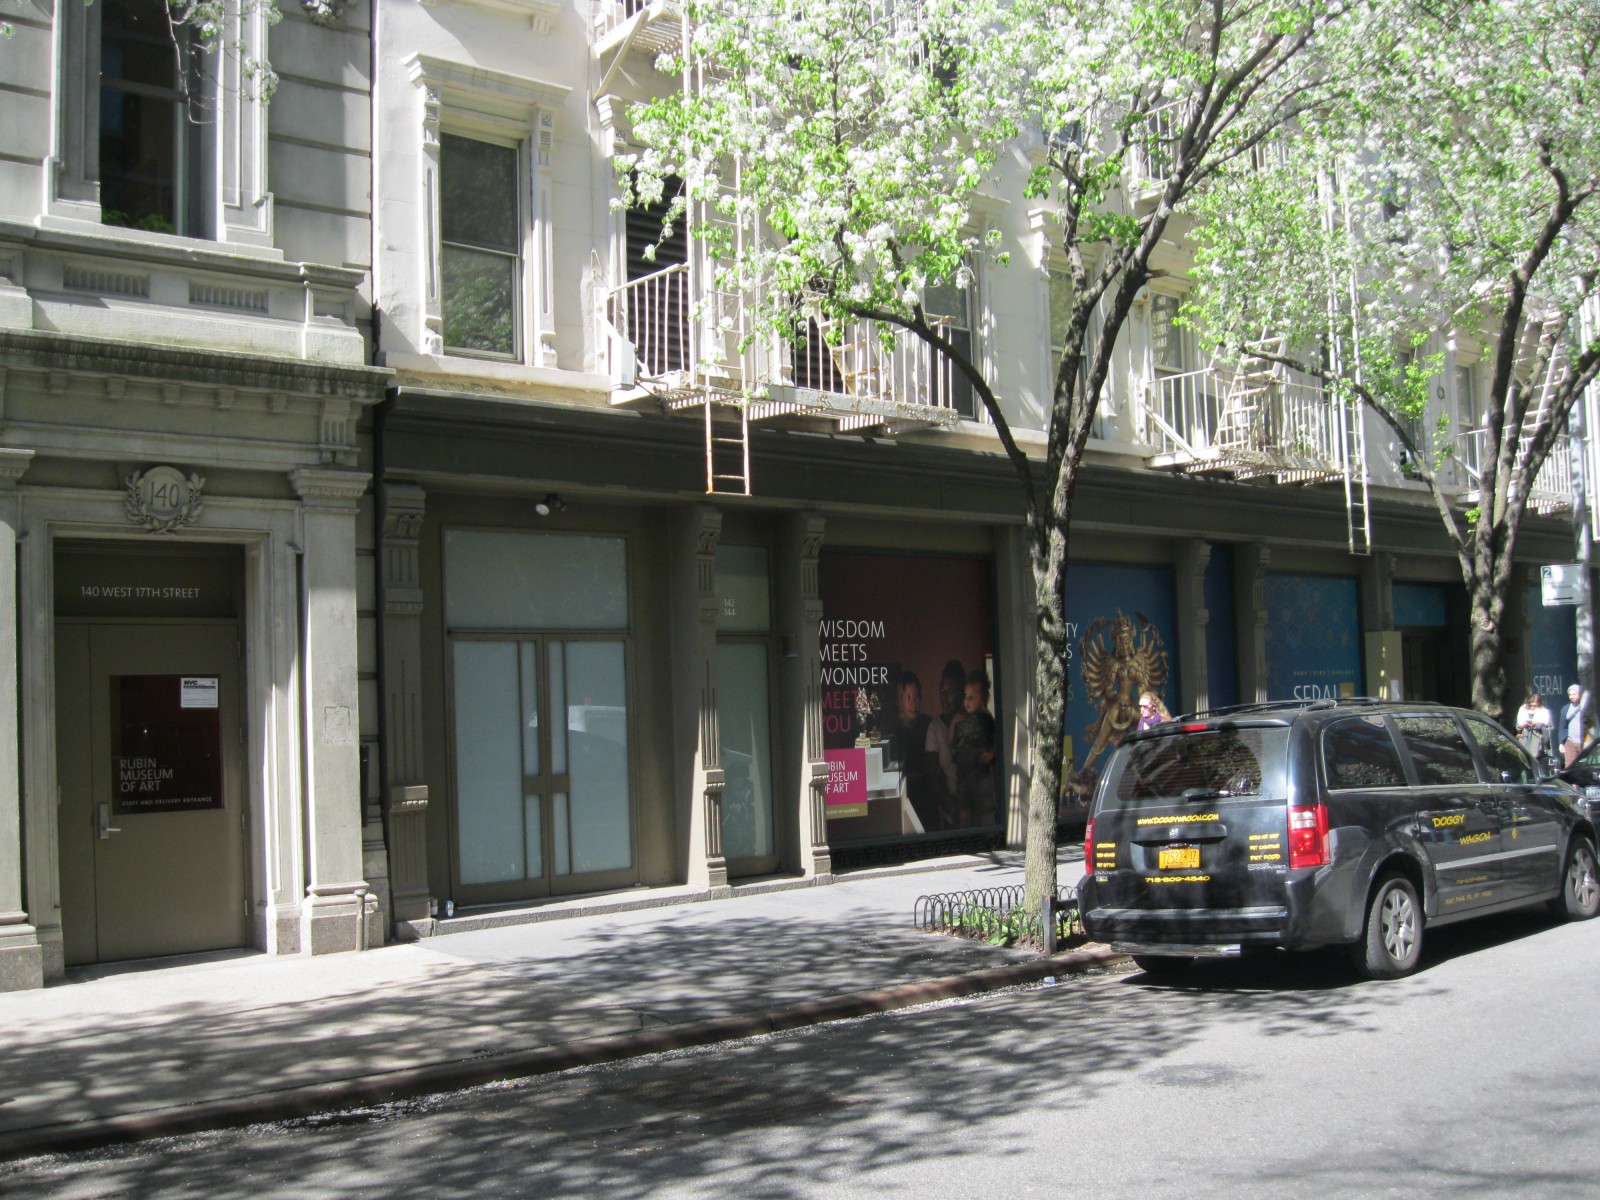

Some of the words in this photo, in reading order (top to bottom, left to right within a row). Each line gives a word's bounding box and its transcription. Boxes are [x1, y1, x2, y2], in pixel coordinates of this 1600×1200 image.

[151, 481, 180, 507] 140
[80, 586, 100, 597] 140
[102, 586, 133, 598] WEST
[135, 587, 161, 598] 17TH
[163, 588, 201, 599] STREET
[723, 598, 735, 607] 142
[724, 608, 736, 617] 144
[818, 620, 885, 638] WISDOM
[819, 643, 868, 662] MEETS
[820, 667, 889, 685] WONDER
[1533, 674, 1563, 696] SERAI
[120, 758, 157, 770] RUBIN
[120, 768, 173, 781] MUSEUM
[827, 770, 858, 783] USEUM
[120, 781, 137, 792] OF
[139, 780, 162, 792] ART
[833, 782, 849, 794] ART
[1432, 814, 1465, 828] DOGGY
[1459, 831, 1491, 845] WAGON
[1263, 853, 1281, 861] FOOD
